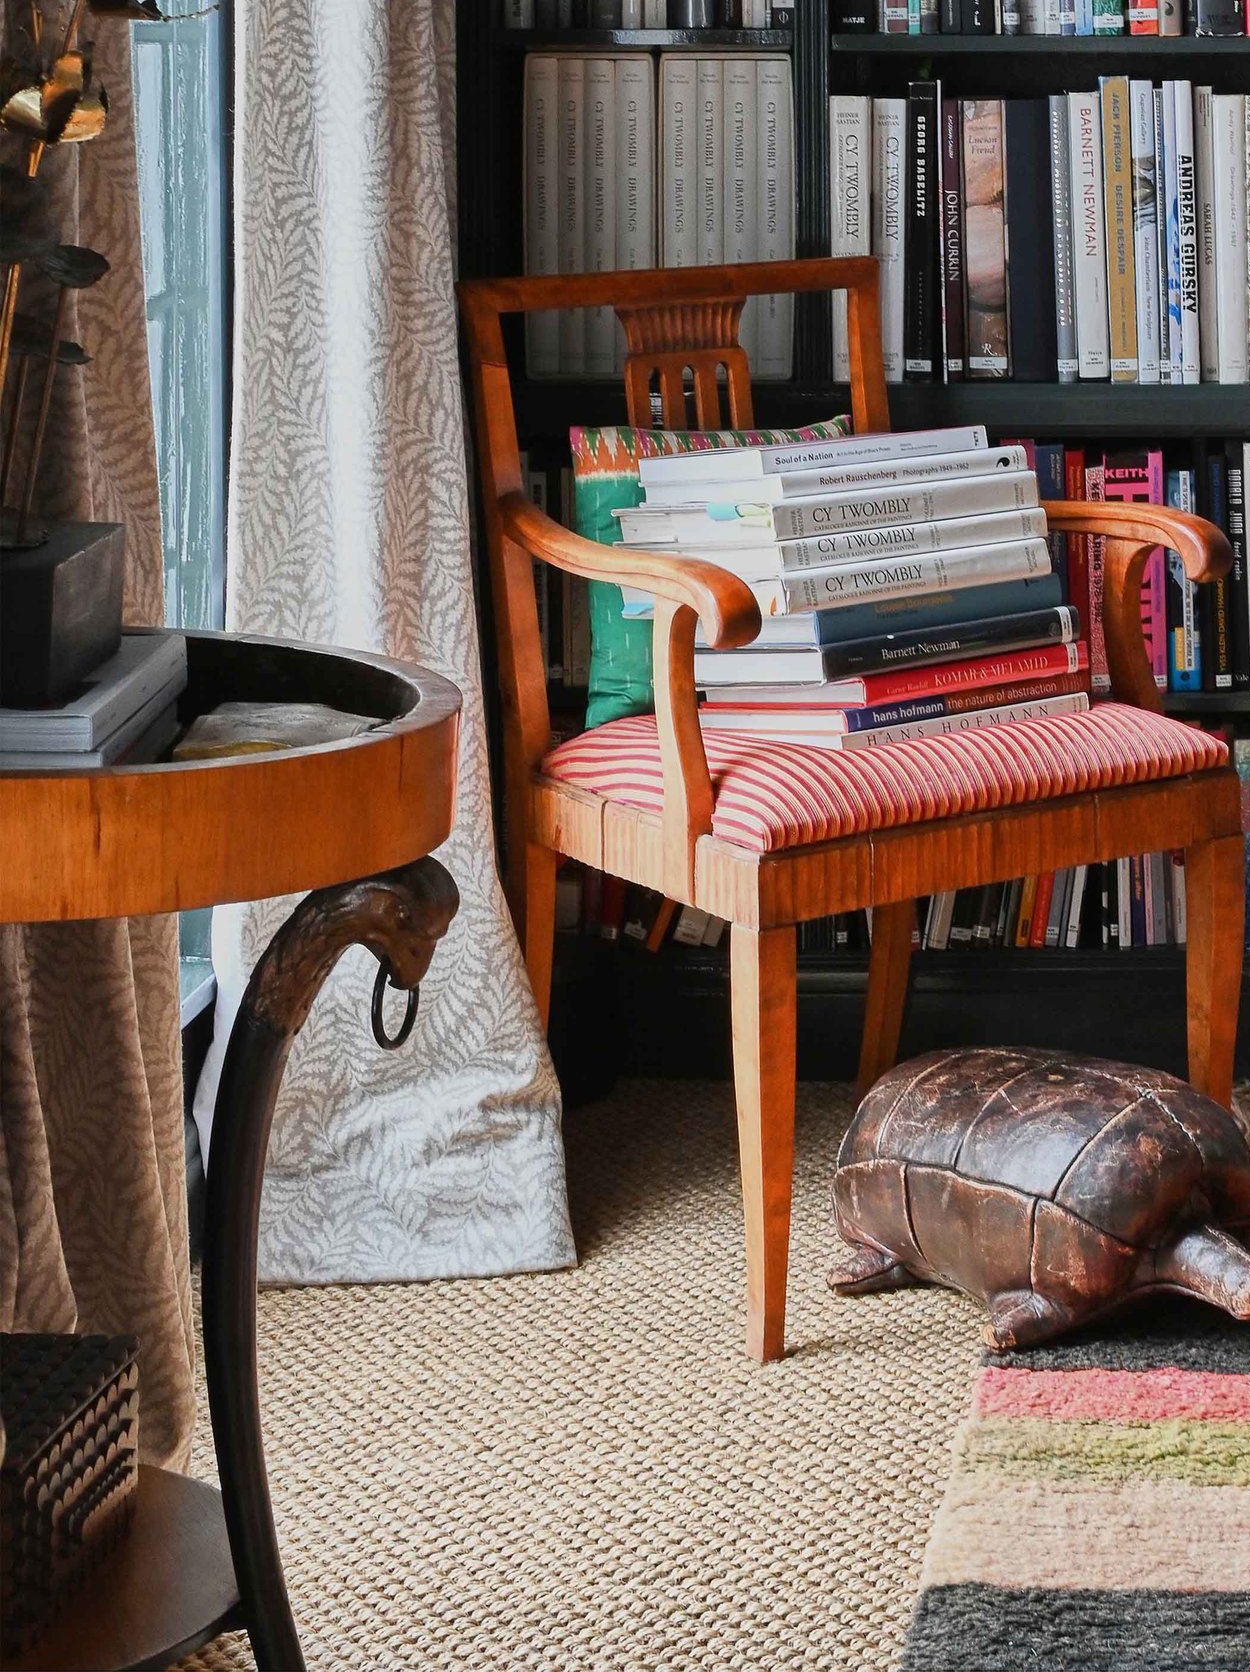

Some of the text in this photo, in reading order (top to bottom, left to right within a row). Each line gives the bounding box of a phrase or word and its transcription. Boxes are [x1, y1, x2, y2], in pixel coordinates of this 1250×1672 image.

[766, 102, 777, 234] CY TWOMBLY DRAWINGS
[845, 134, 860, 240] CY TWOMBLY
[886, 136, 899, 241] CY TWOMBLY
[916, 115, 926, 217] GEORG BASELITZ
[1080, 107, 1097, 257] BARNETT NEWMAN
[945, 189, 961, 281] JOHN CURRIN
[1179, 153, 1197, 314] ANDREAS GURSKY
[813, 497, 911, 523] CY TWOMBLY
[818, 527, 916, 553] CY TWOMBLY
[825, 564, 923, 592] CY TWOMBLY
[881, 639, 960, 660] Barnett Newman
[867, 704, 1049, 747] HANS HOFMANN
